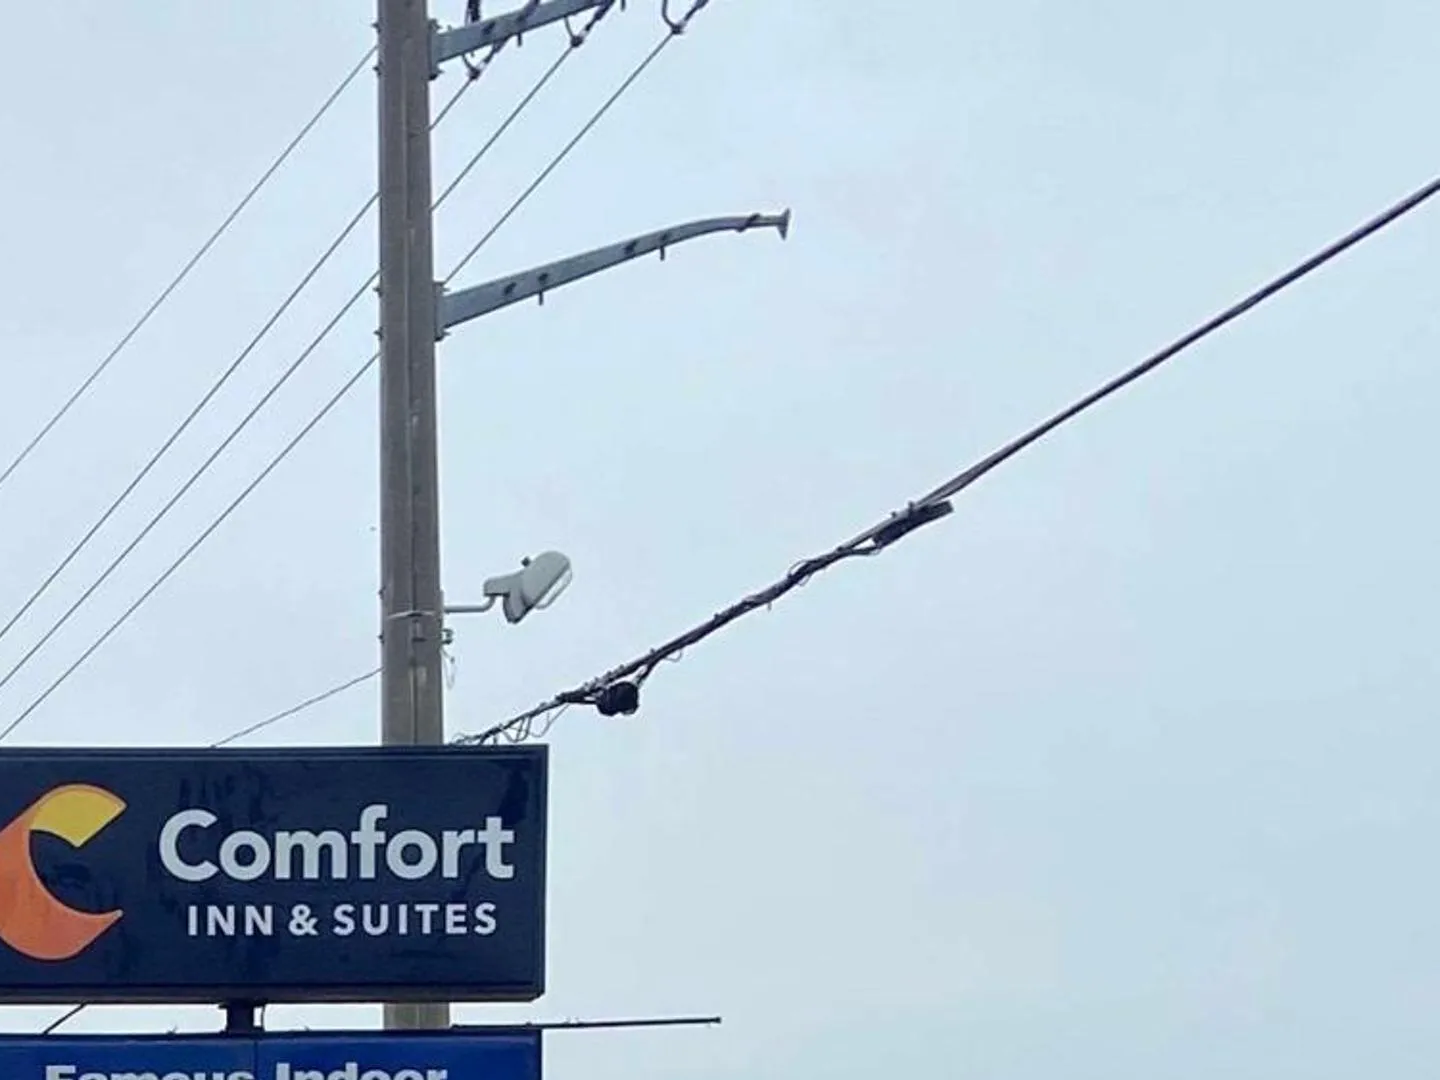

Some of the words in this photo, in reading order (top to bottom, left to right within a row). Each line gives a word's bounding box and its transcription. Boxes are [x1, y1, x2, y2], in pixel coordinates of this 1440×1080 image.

[159, 804, 515, 882] Comfort
[188, 905, 273, 936] INN
[288, 904, 318, 936] &
[333, 902, 497, 936] SUITES
